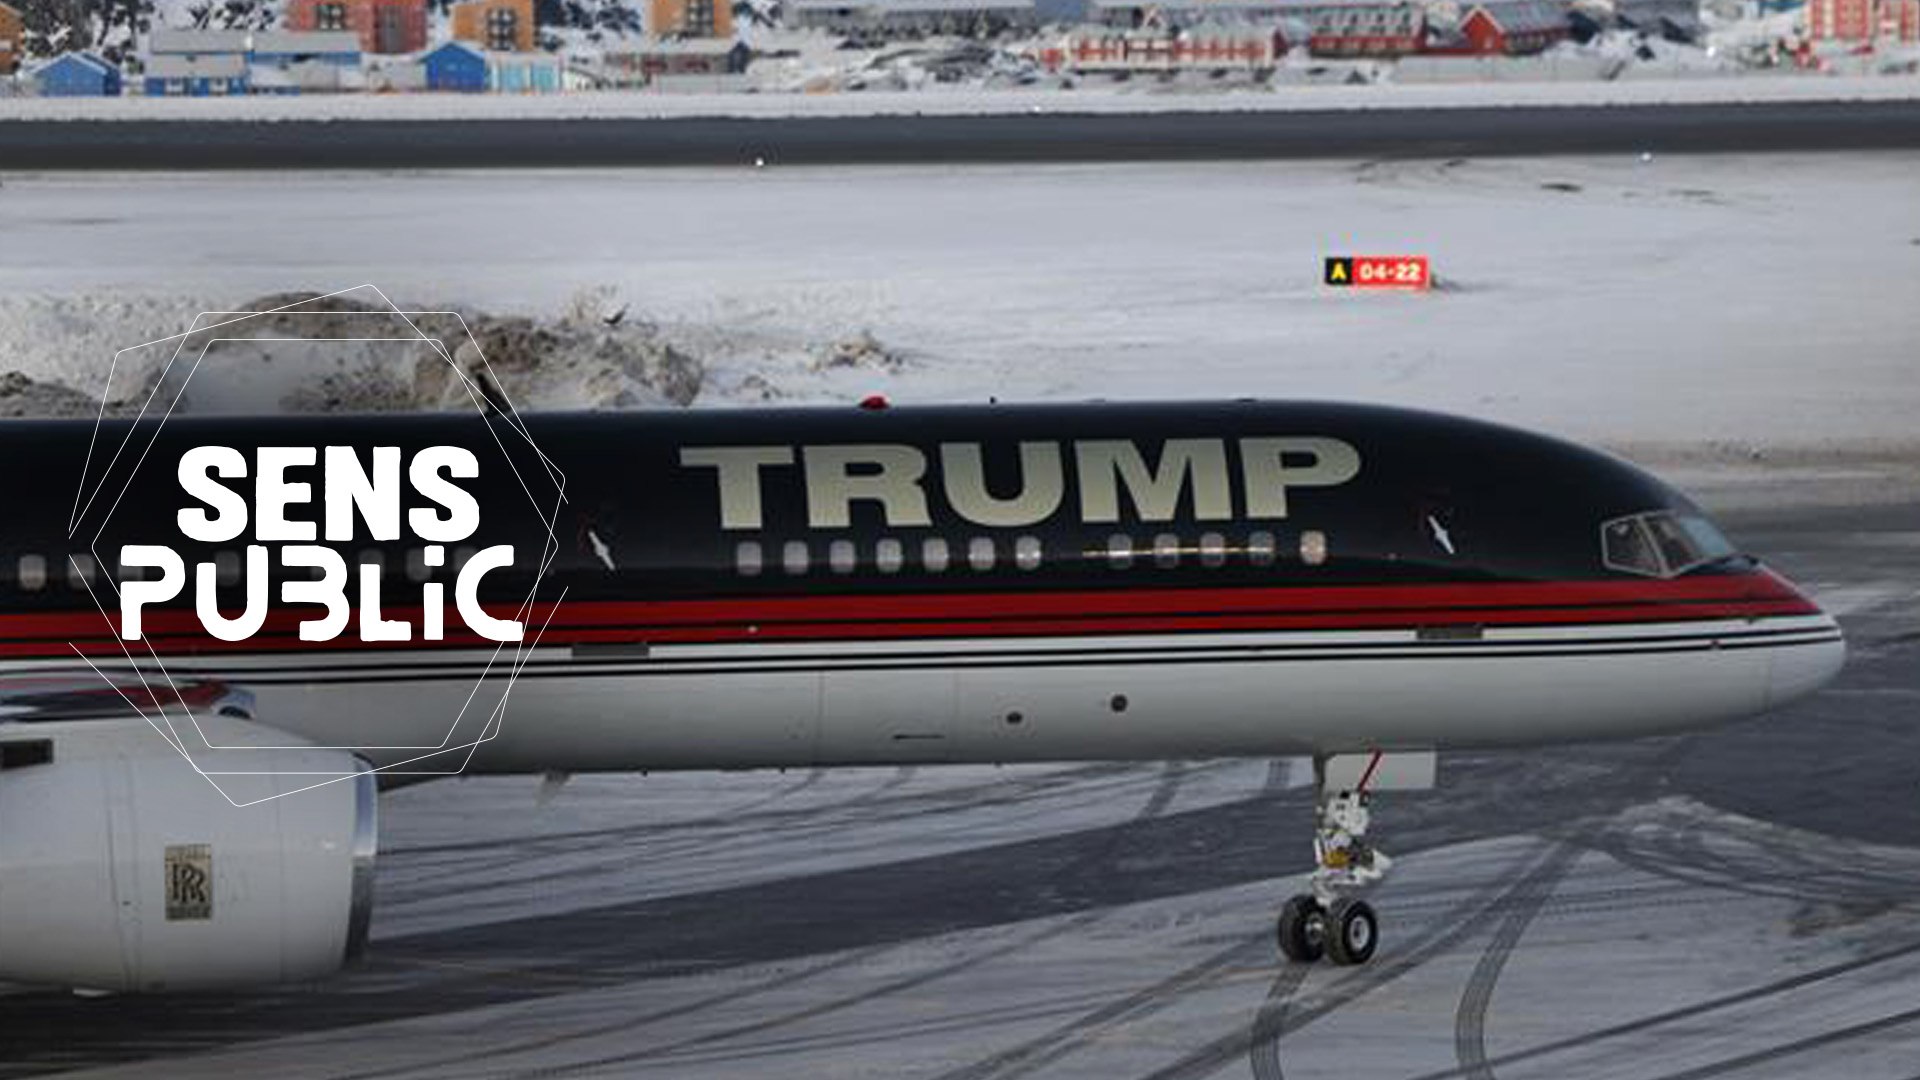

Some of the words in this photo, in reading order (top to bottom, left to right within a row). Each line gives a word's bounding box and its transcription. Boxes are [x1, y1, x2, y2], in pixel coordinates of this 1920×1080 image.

[1330, 262, 1347, 280] A
[1359, 261, 1422, 281] 04-22
[680, 436, 1362, 530] TRUMP
